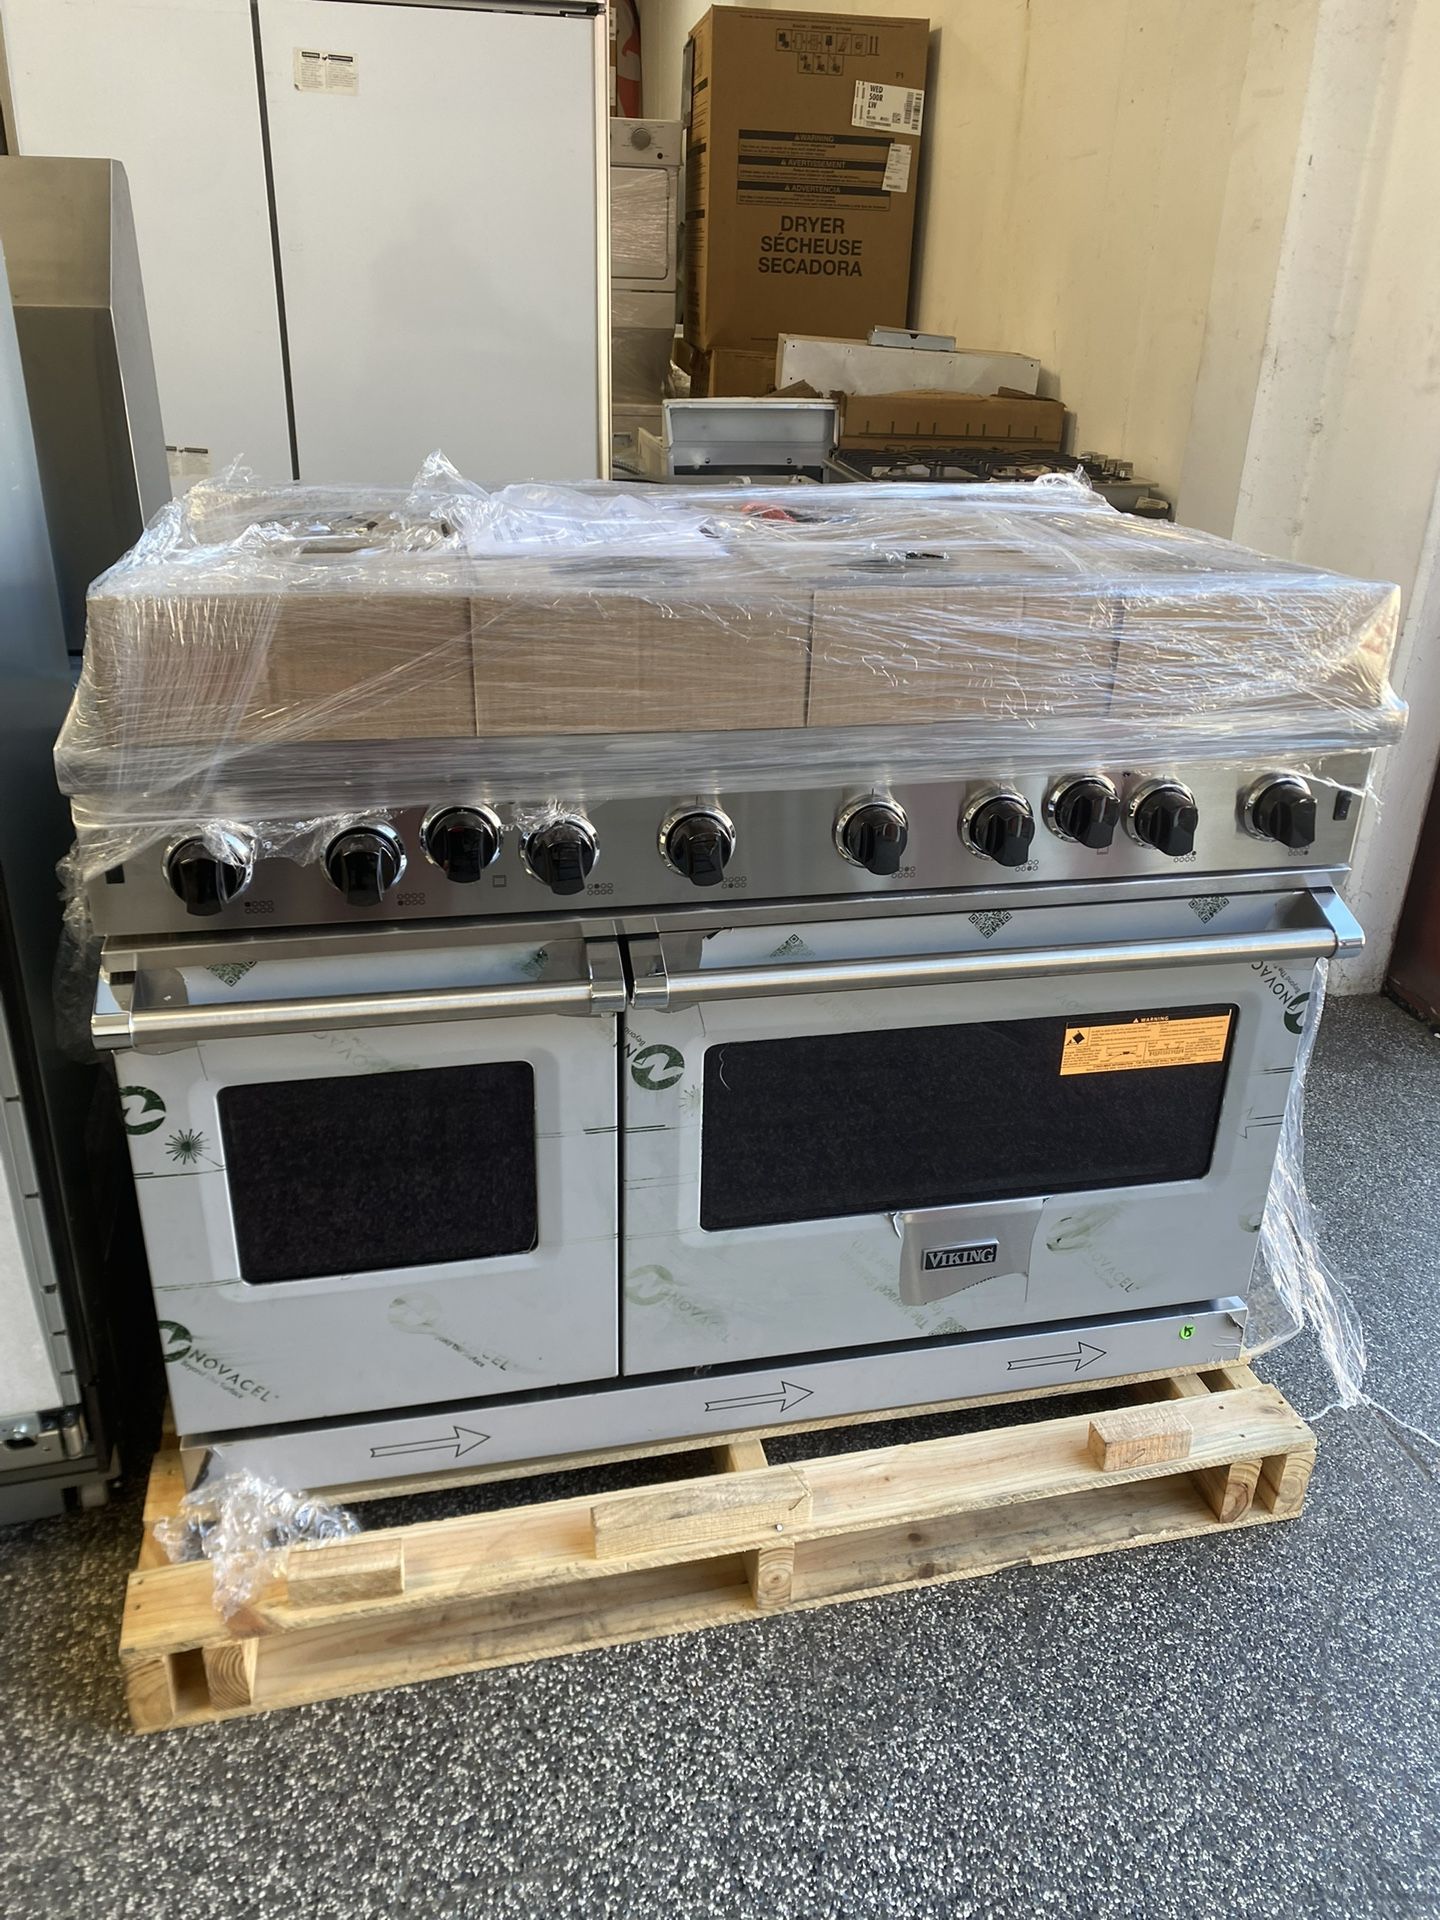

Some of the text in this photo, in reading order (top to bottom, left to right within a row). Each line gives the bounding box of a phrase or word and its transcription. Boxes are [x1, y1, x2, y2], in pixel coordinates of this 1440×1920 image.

[870, 85, 884, 94] WED
[869, 93, 883, 102] 500R
[801, 135, 834, 143] WARNING
[788, 160, 846, 169] AVERTISSEMENT
[792, 185, 841, 194] ADVERTENCIA
[781, 215, 845, 234] DRYER
[760, 233, 863, 256] SÉCHEUSE
[758, 257, 863, 276] SECADORA
[928, 1247, 995, 1268] VIKING
[188, 1349, 271, 1402] NOVACEL
